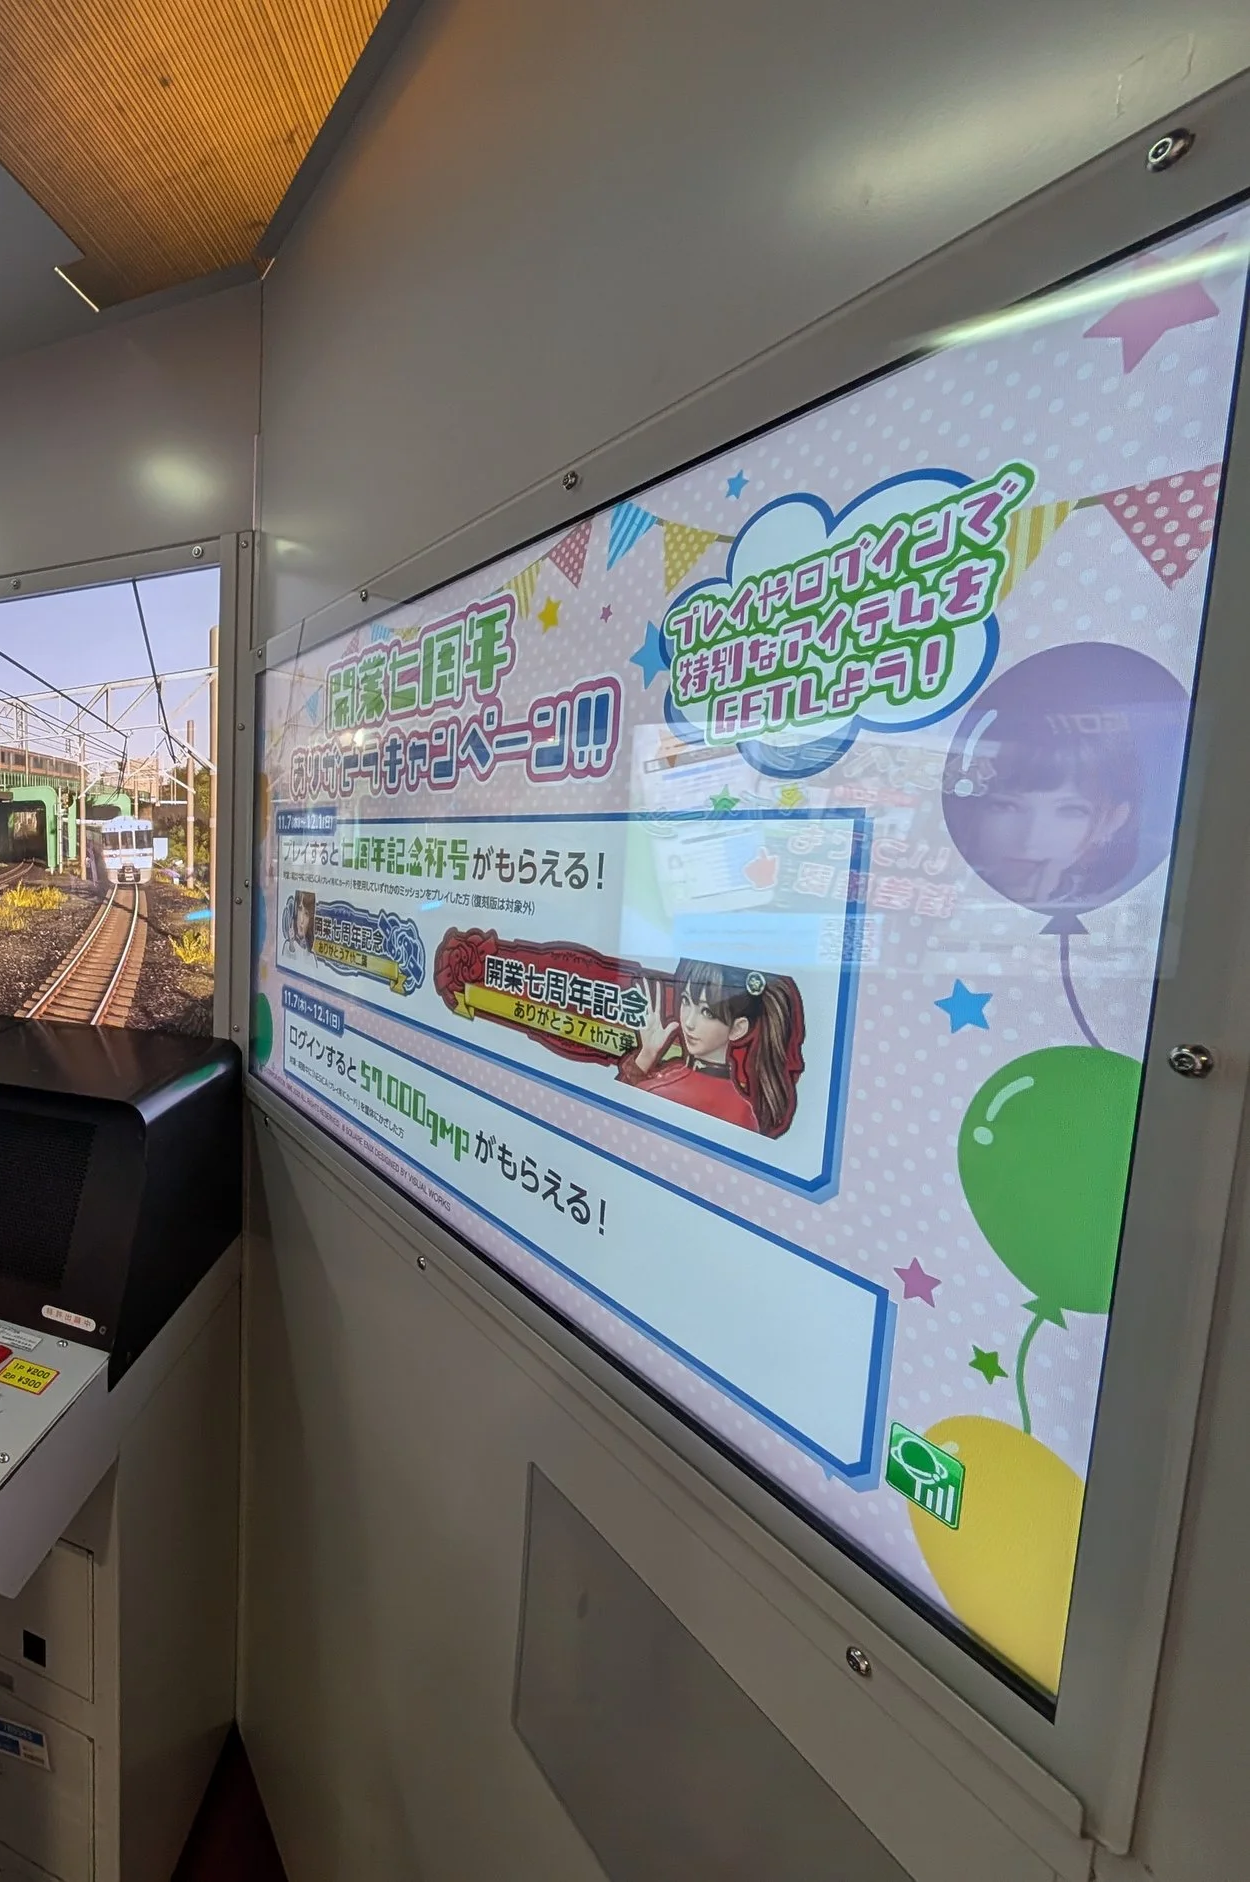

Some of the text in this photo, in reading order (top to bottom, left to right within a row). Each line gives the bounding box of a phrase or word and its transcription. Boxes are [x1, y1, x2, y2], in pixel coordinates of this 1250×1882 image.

[670, 476, 1022, 648] プレイやログインで
[676, 559, 992, 698] 特別なアイテムを
[327, 600, 513, 734] 開業七周年
[711, 634, 949, 738] GETしよう!
[314, 916, 385, 954] 開業七周年記念
[483, 953, 650, 1029] 開業七周年記念
[409, 1174, 427, 1195] VISUAL
[428, 1189, 451, 1212] WORKS
[3, 1372, 42, 1389] 2P ¥300
[27, 1366, 50, 1379] ¥200
